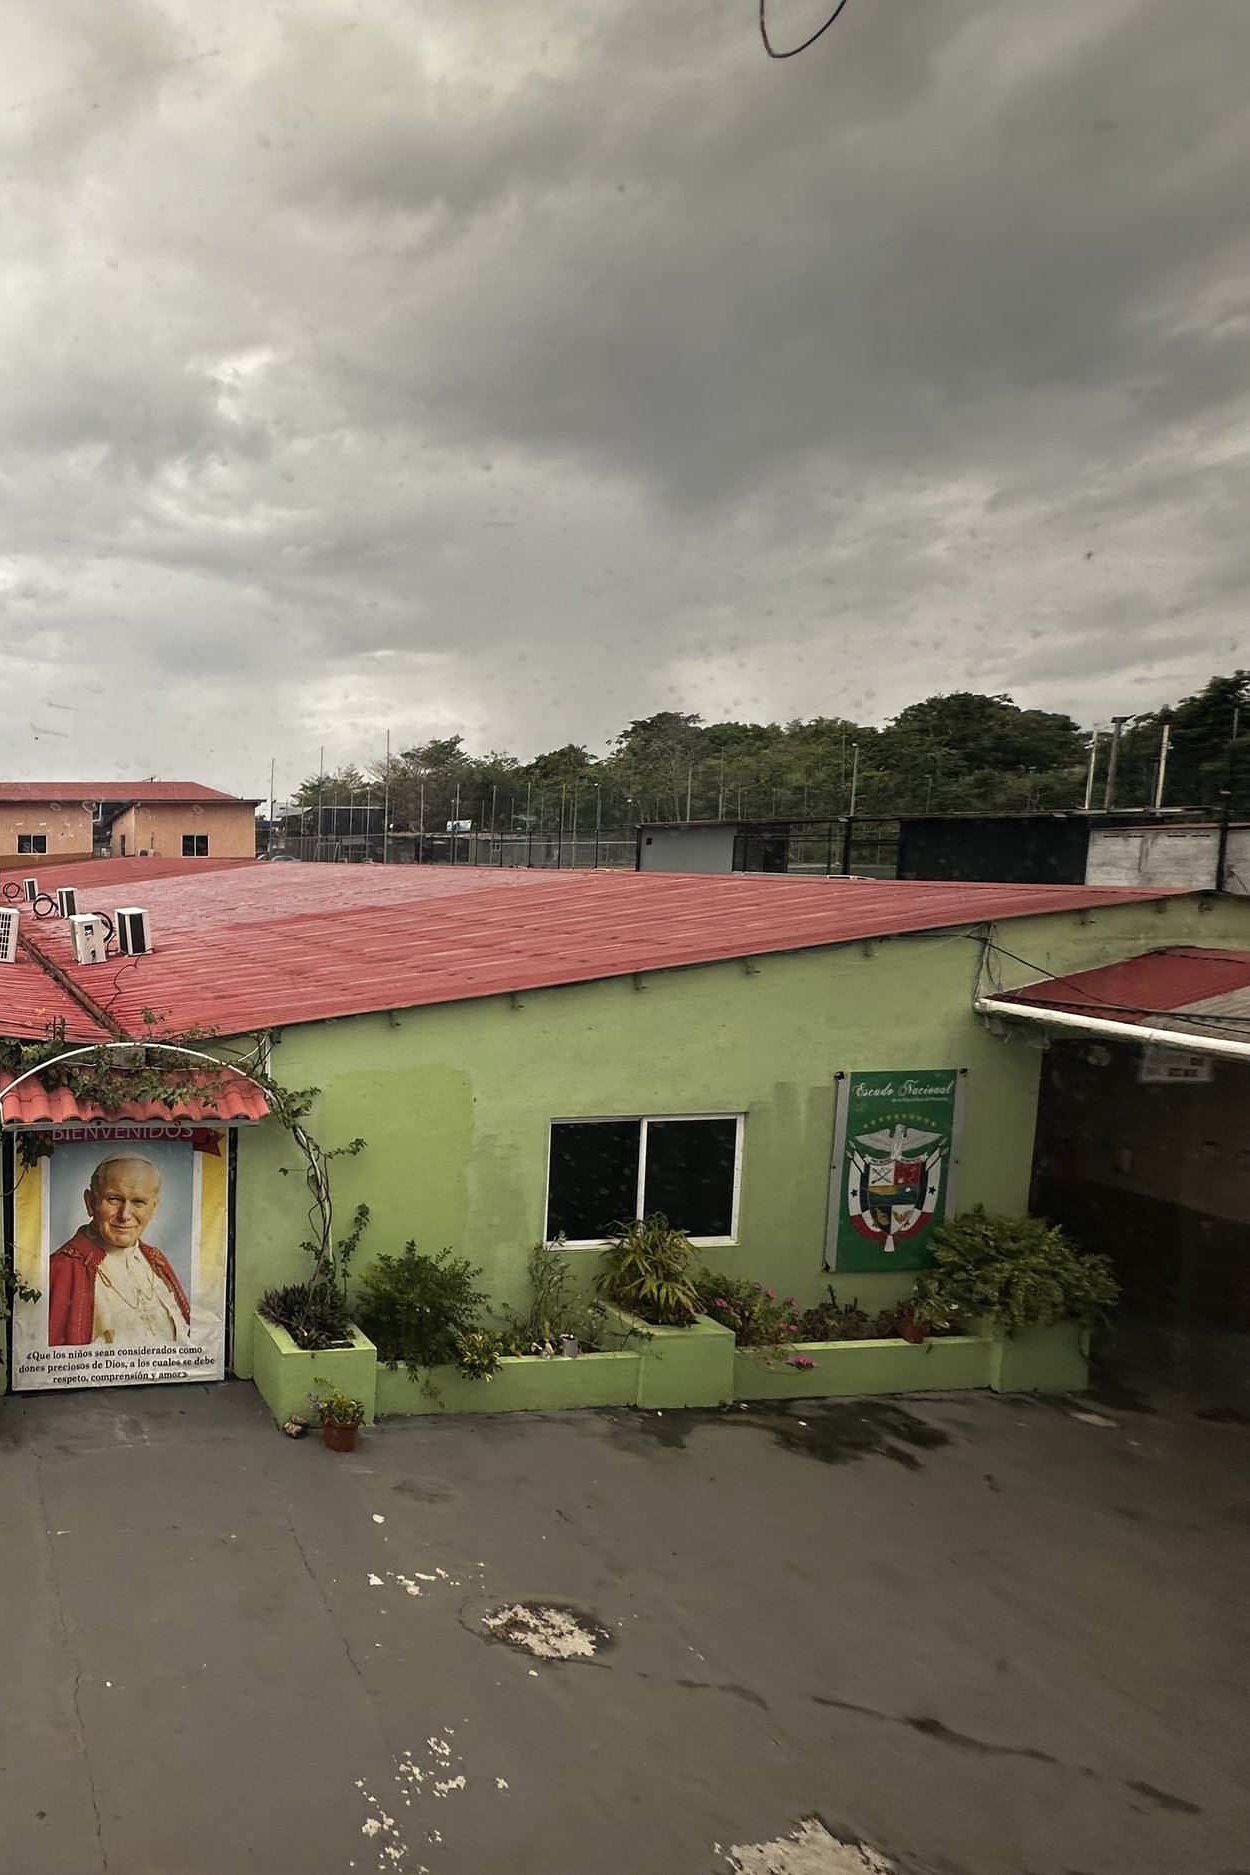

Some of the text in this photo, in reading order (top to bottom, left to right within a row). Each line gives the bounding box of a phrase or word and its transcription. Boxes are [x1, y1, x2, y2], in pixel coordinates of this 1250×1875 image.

[854, 1080, 954, 1097] Escudo Nacional
[52, 1127, 194, 1141] BIENVENIDOS
[53, 1350, 66, 1360] los
[68, 1349, 92, 1359] niños
[94, 1350, 115, 1358] sean
[117, 1345, 177, 1356] considerados
[178, 1346, 203, 1354] como
[18, 1364, 45, 1374] dones
[47, 1362, 90, 1374] preciosos
[92, 1361, 103, 1369] de
[105, 1360, 128, 1370] Dios,
[137, 1359, 150, 1368] los
[152, 1357, 181, 1367] cuales
[182, 1358, 193, 1366] se
[194, 1356, 216, 1366] debe
[52, 1374, 89, 1385] respeto,
[91, 1370, 149, 1383] comprensión
[150, 1372, 156, 1380] y
